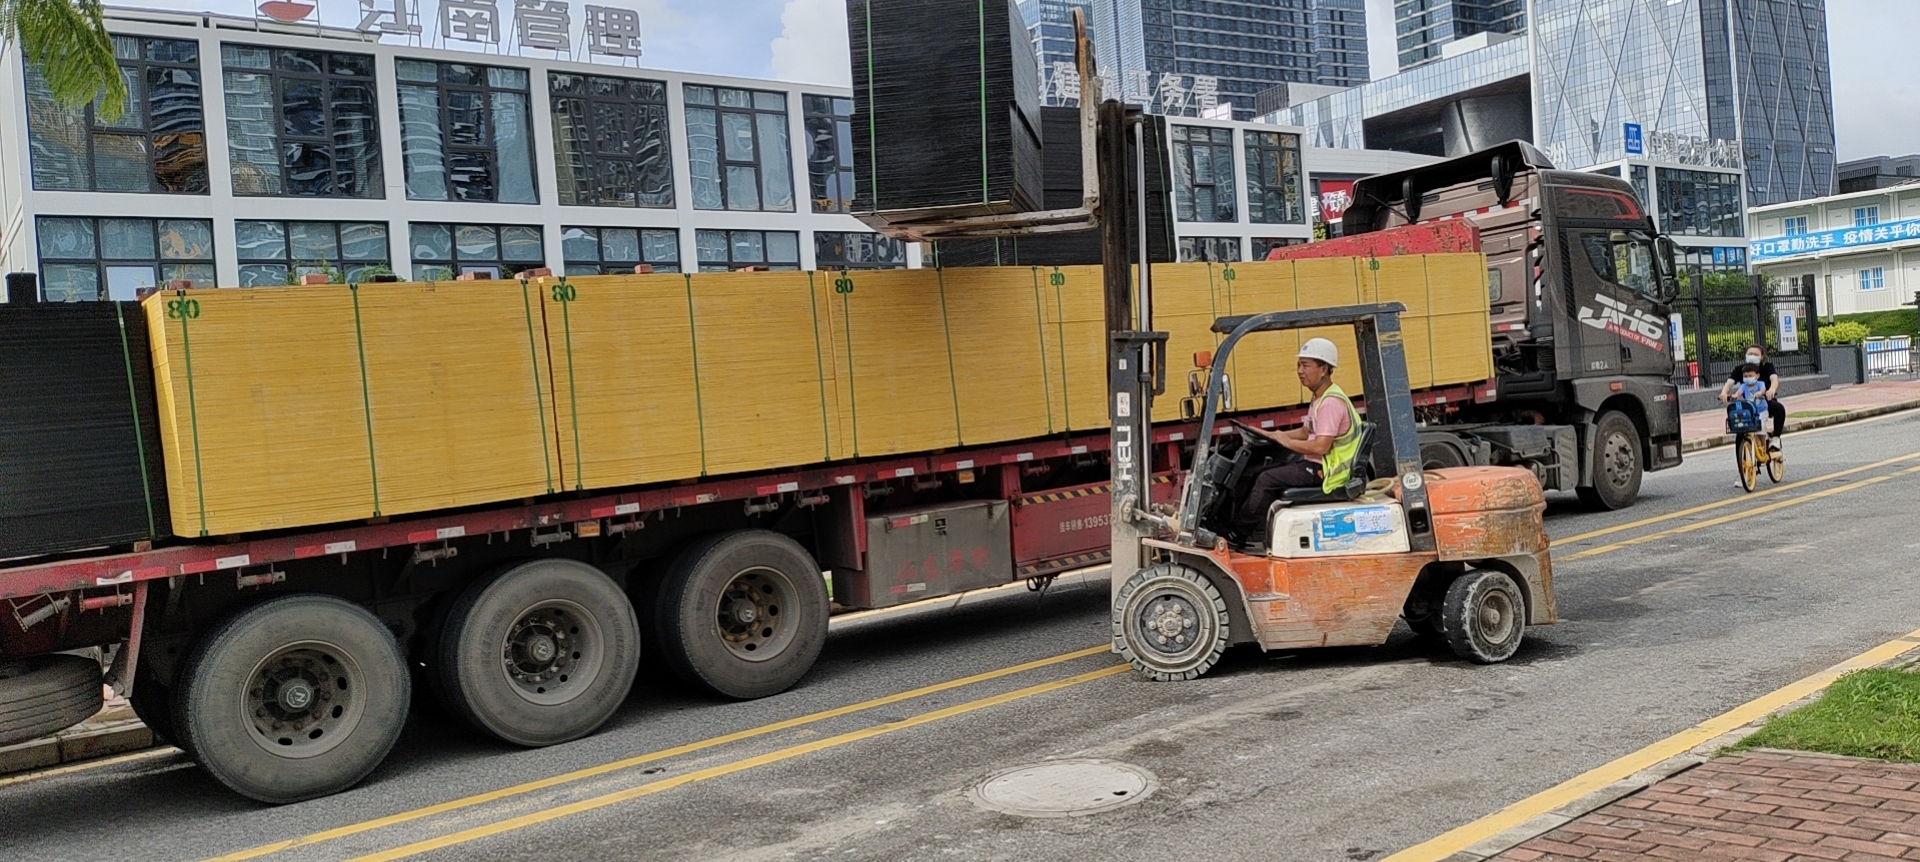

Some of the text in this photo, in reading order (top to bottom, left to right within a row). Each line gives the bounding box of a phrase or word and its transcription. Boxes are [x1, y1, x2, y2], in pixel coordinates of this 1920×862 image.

[356, 0, 642, 56] 江南管理
[1038, 60, 1218, 109] 建筑工务署
[1843, 223, 1920, 245] 疫情关乎你
[1050, 272, 1065, 286] 80
[1222, 268, 1236, 281] 80
[551, 284, 576, 302] 80
[834, 278, 854, 294] 80
[167, 299, 200, 319] 80
[1117, 425, 1132, 481] HELI
